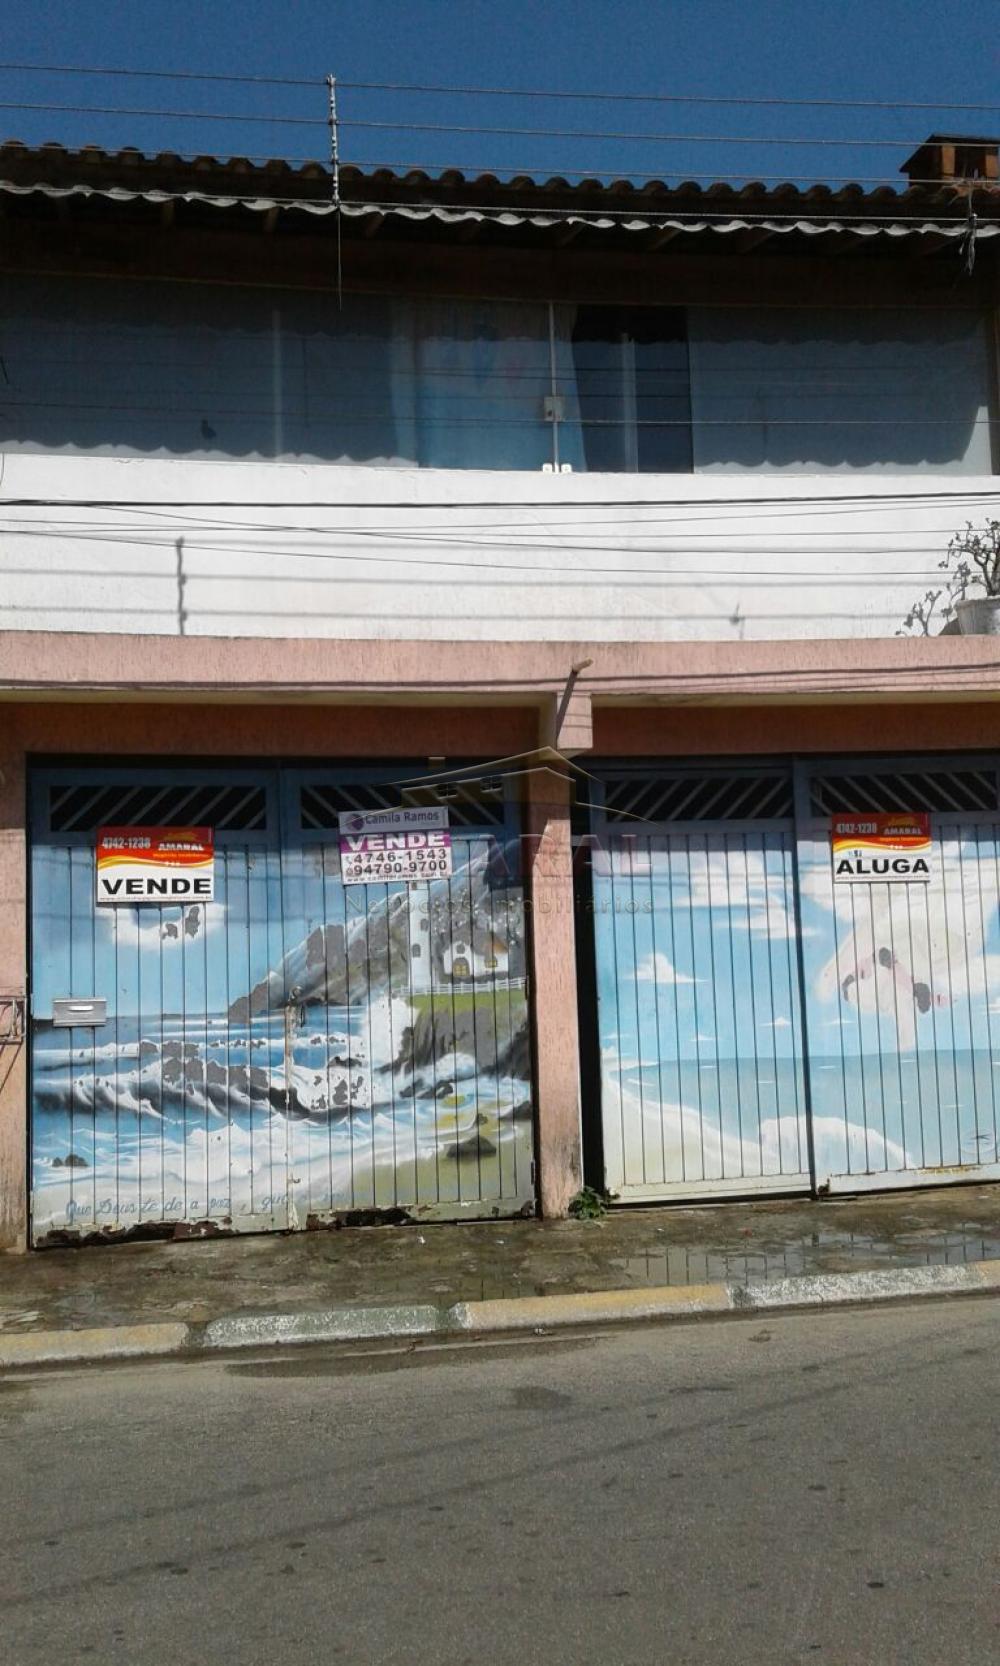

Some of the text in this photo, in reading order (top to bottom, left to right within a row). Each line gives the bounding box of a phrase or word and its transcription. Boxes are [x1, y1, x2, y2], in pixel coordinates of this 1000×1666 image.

[365, 812, 440, 824] Camila Ramos
[345, 831, 445, 851] VENDE
[354, 848, 446, 863] 4746-1543
[354, 860, 447, 876] 94790-9700
[836, 858, 929, 875] ALUGA
[102, 878, 211, 895] VENDE
